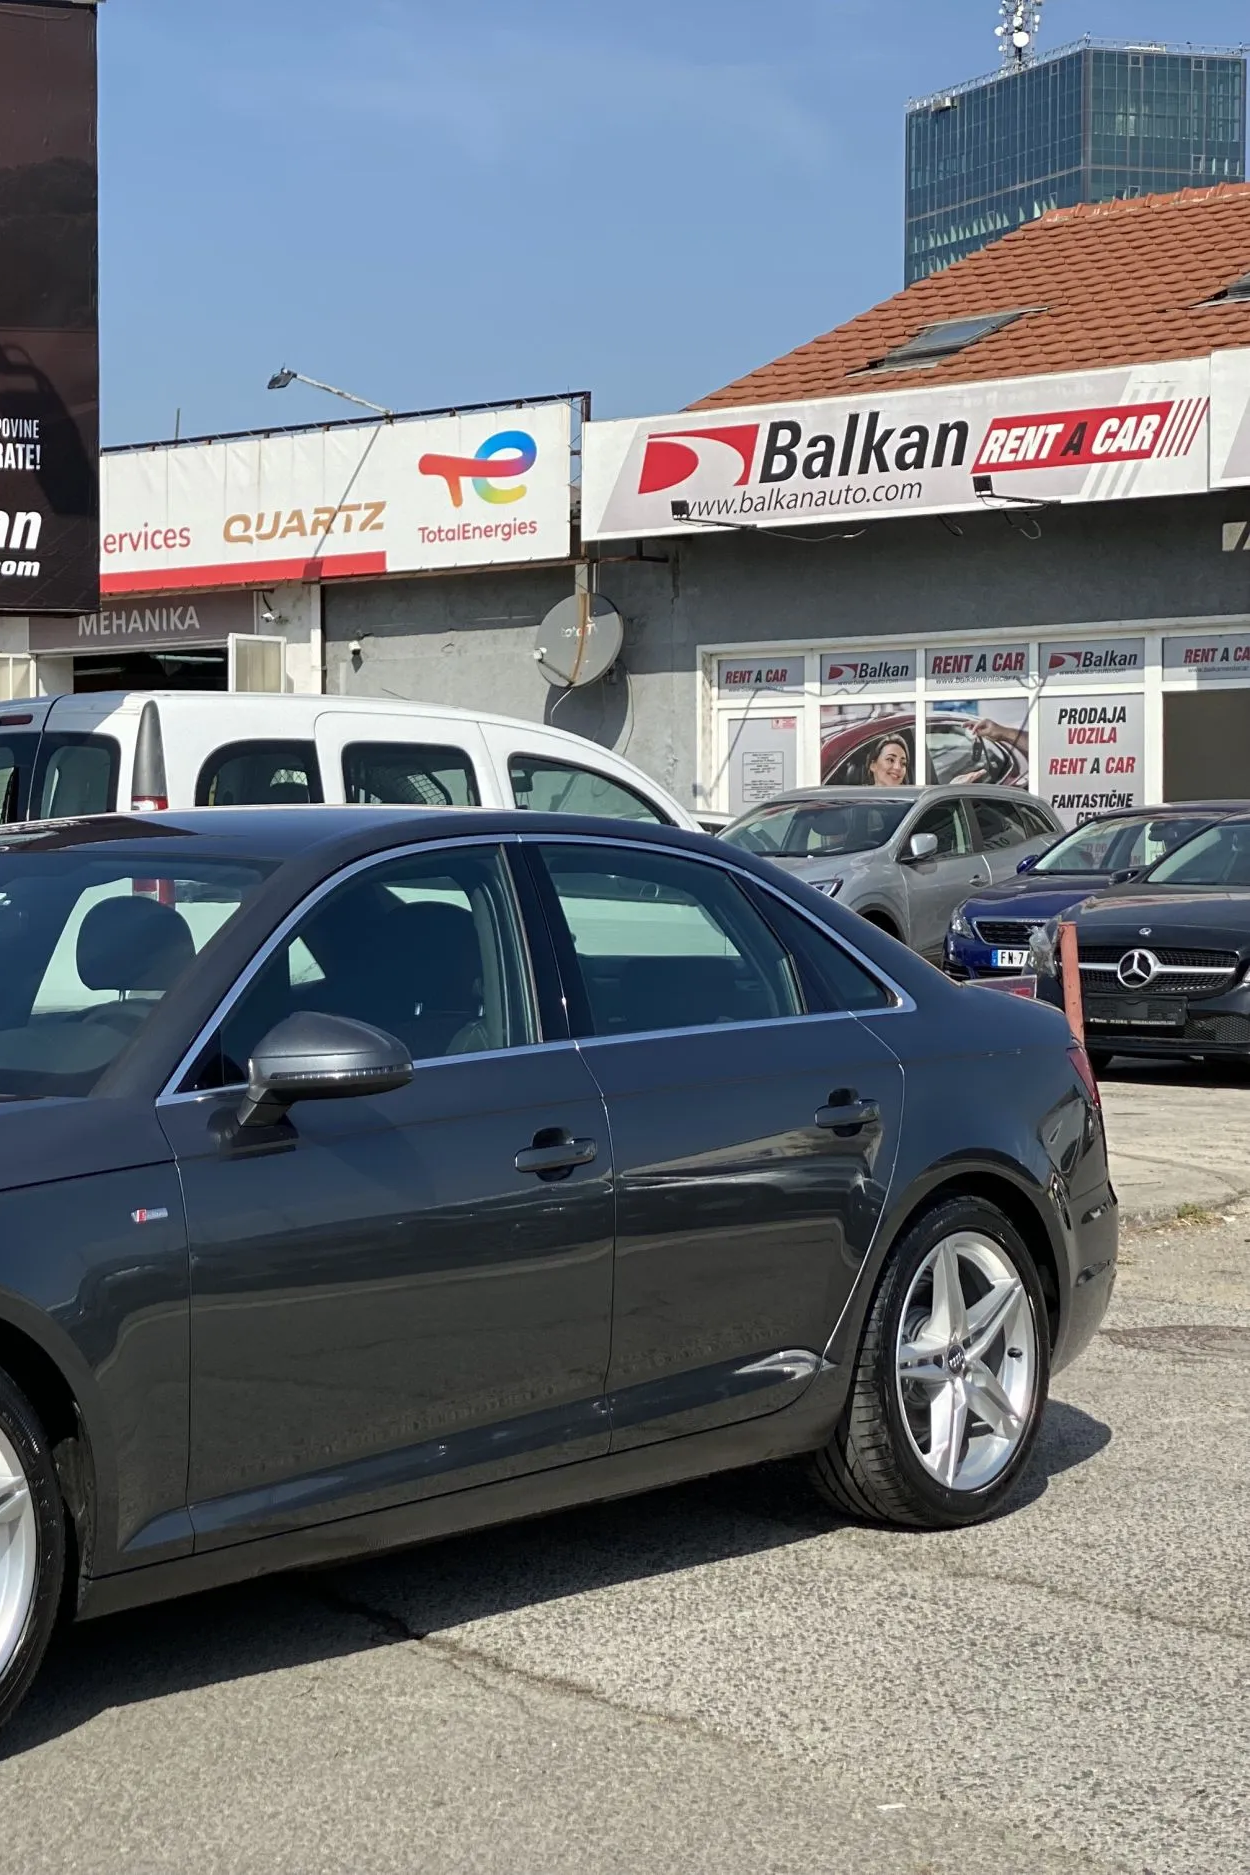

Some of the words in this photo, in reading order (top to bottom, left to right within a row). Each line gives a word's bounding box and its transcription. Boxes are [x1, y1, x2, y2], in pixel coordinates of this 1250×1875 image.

[759, 410, 969, 484] Balkan
[978, 423, 1065, 464] RENT
[1059, 421, 1088, 457] A
[1091, 414, 1161, 455] CAR
[222, 501, 387, 545] QUARTZ
[418, 517, 537, 543] TotalEnergies
[102, 522, 191, 554] ervices
[78, 606, 200, 637] MEHANIKA
[932, 654, 973, 674] RENT
[975, 654, 987, 672] A
[992, 652, 1026, 672] CAR
[1082, 651, 1138, 668] Balkan
[1183, 648, 1218, 664] RENT
[1220, 647, 1230, 662] A
[1234, 646, 1250, 662] CA
[725, 670, 753, 684] RENT
[754, 669, 762, 683] A
[766, 668, 789, 683] CAR
[859, 662, 909, 679] Balkan
[1058, 706, 1126, 725] PRODAJA
[1068, 727, 1117, 744] VOZILA
[1049, 757, 1087, 775] RENT
[1090, 757, 1100, 774] A
[1105, 757, 1136, 774] CAR
[1051, 789, 1134, 809] FANTASTIČNE
